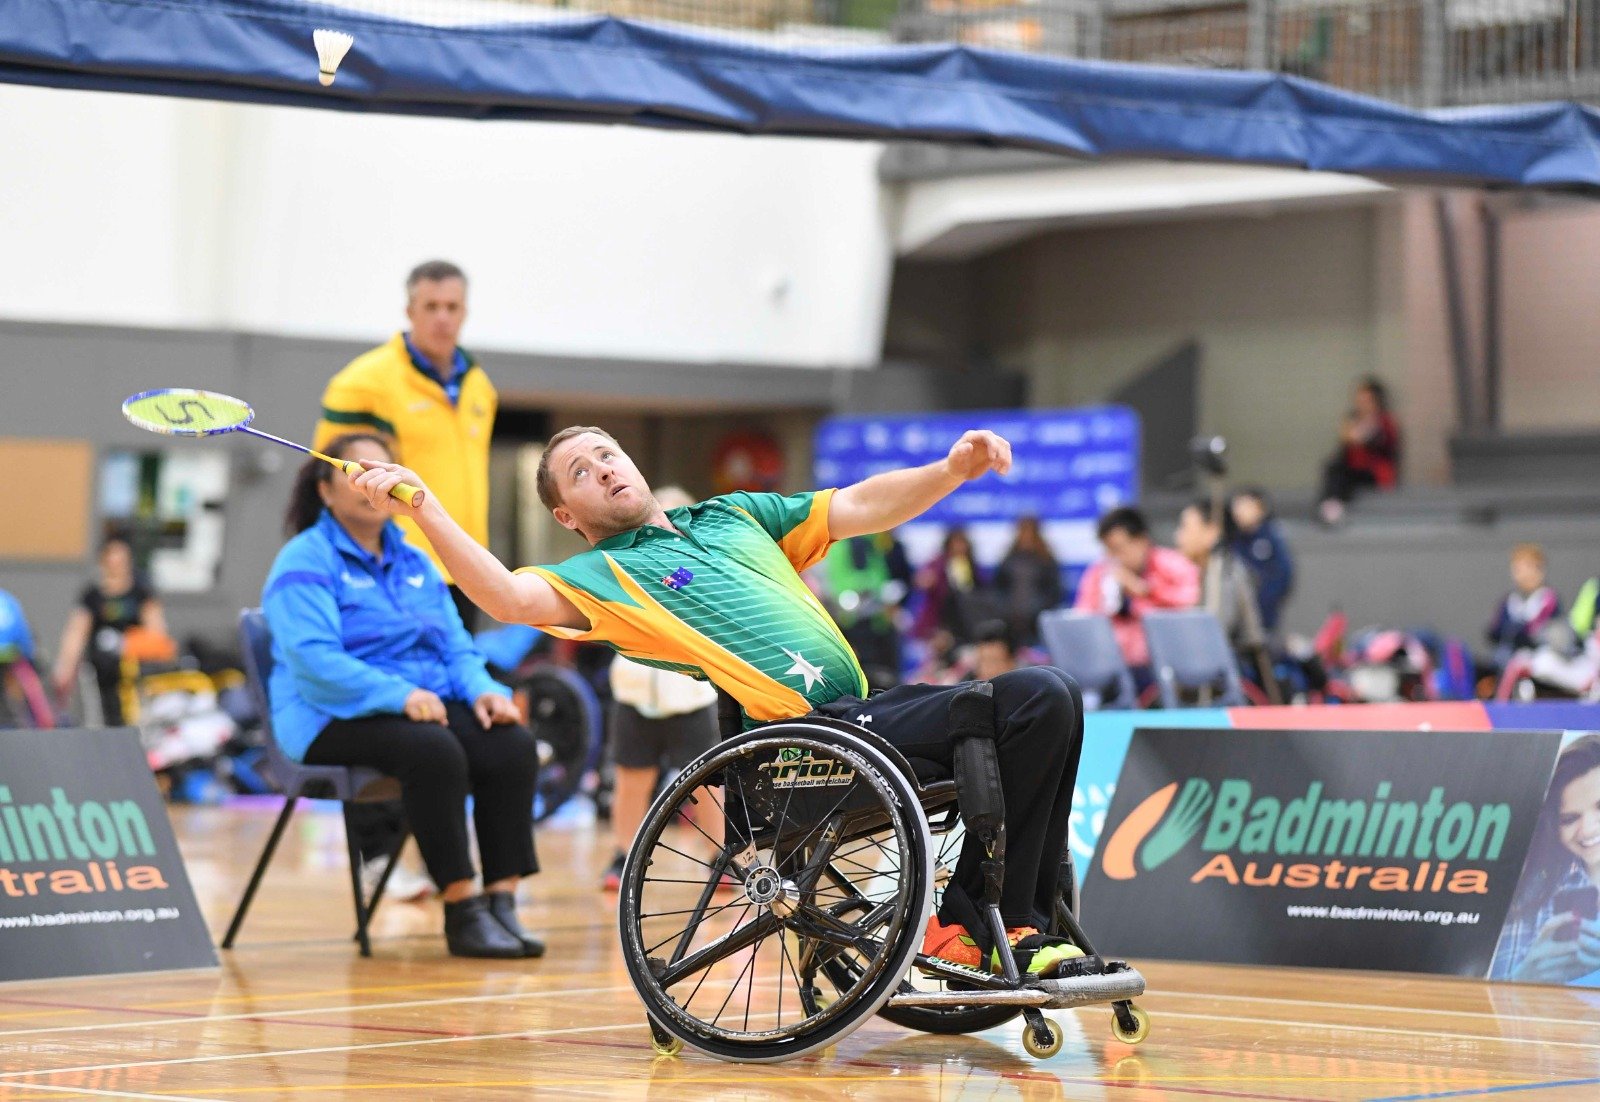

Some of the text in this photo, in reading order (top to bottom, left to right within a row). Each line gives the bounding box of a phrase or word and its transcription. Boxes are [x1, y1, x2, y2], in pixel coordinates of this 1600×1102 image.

[674, 759, 704, 788] KENDA
[815, 777, 851, 786] whelchair
[1202, 779, 1511, 861] Badminton
[1191, 854, 1489, 894] Australia
[0, 907, 180, 928] ww.badminton.org.au
[1286, 904, 1480, 925] www.badminton.org.au
